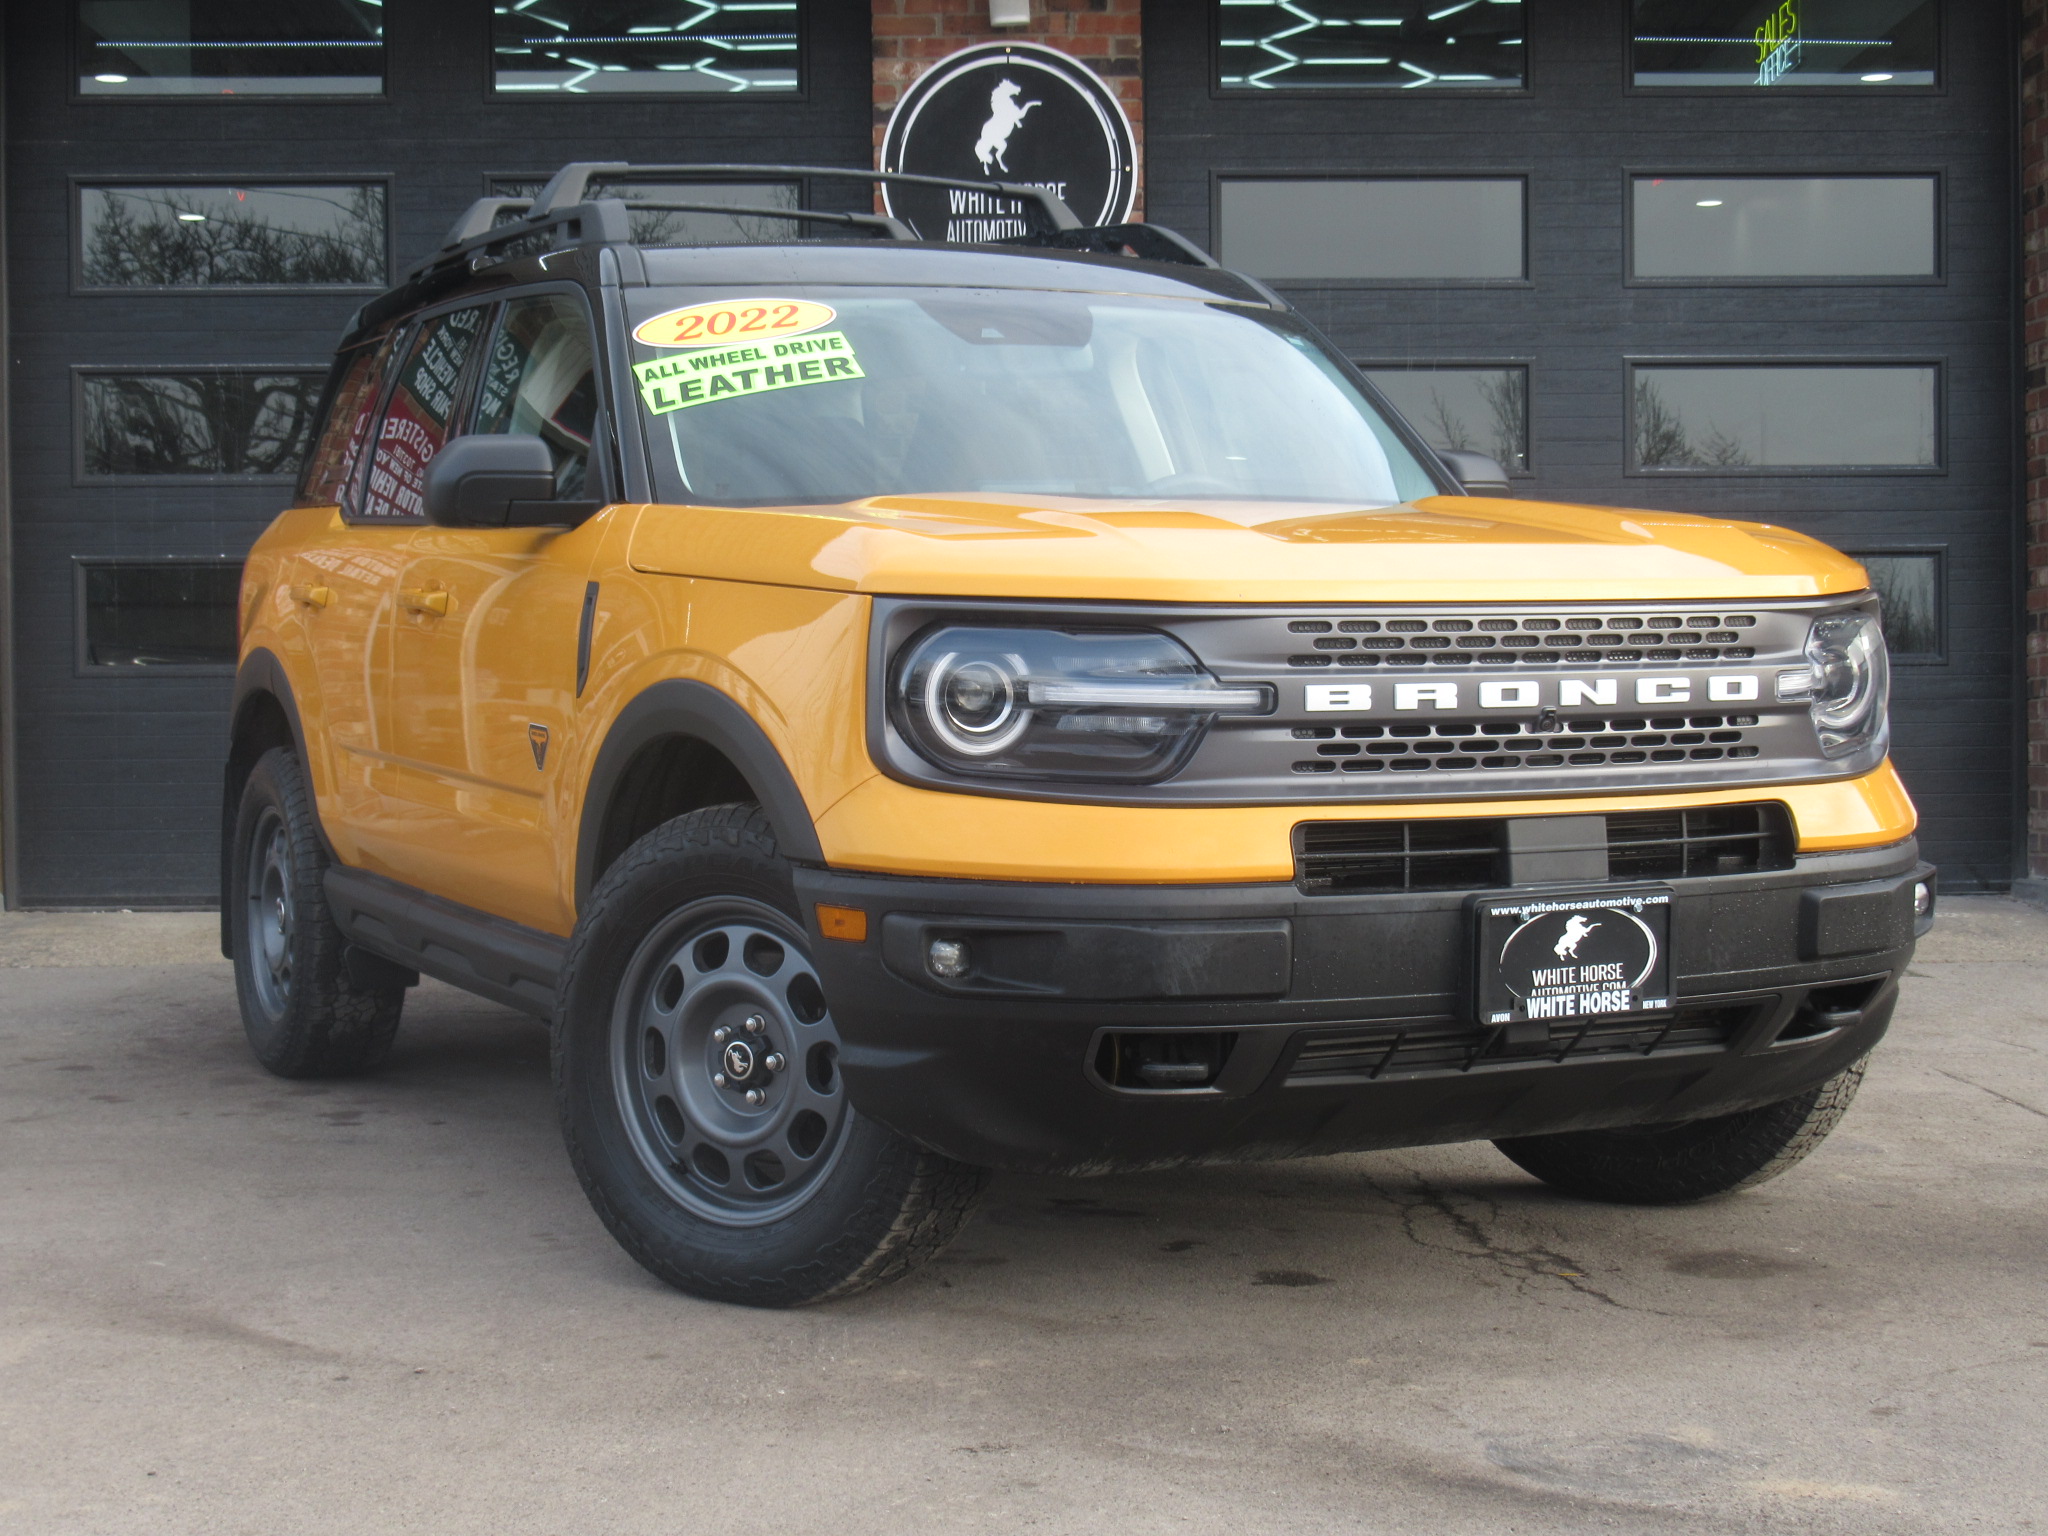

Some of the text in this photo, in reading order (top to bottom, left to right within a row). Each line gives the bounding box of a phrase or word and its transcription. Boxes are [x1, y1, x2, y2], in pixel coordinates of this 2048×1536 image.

[1755, 0, 1797, 63] SALES
[1755, 37, 1798, 86] OFFICE
[673, 304, 799, 341] 2022
[645, 337, 843, 382] ALL WHEEL DRIVE
[652, 356, 856, 409] LEATHER
[1304, 675, 1759, 712] BRONCO
[1491, 895, 1669, 916] www.whitehorseautomotive.com
[1532, 963, 1624, 987] WHITE HORSE
[1491, 990, 1668, 1023] AVON WHITE HORSE NEW YORK
